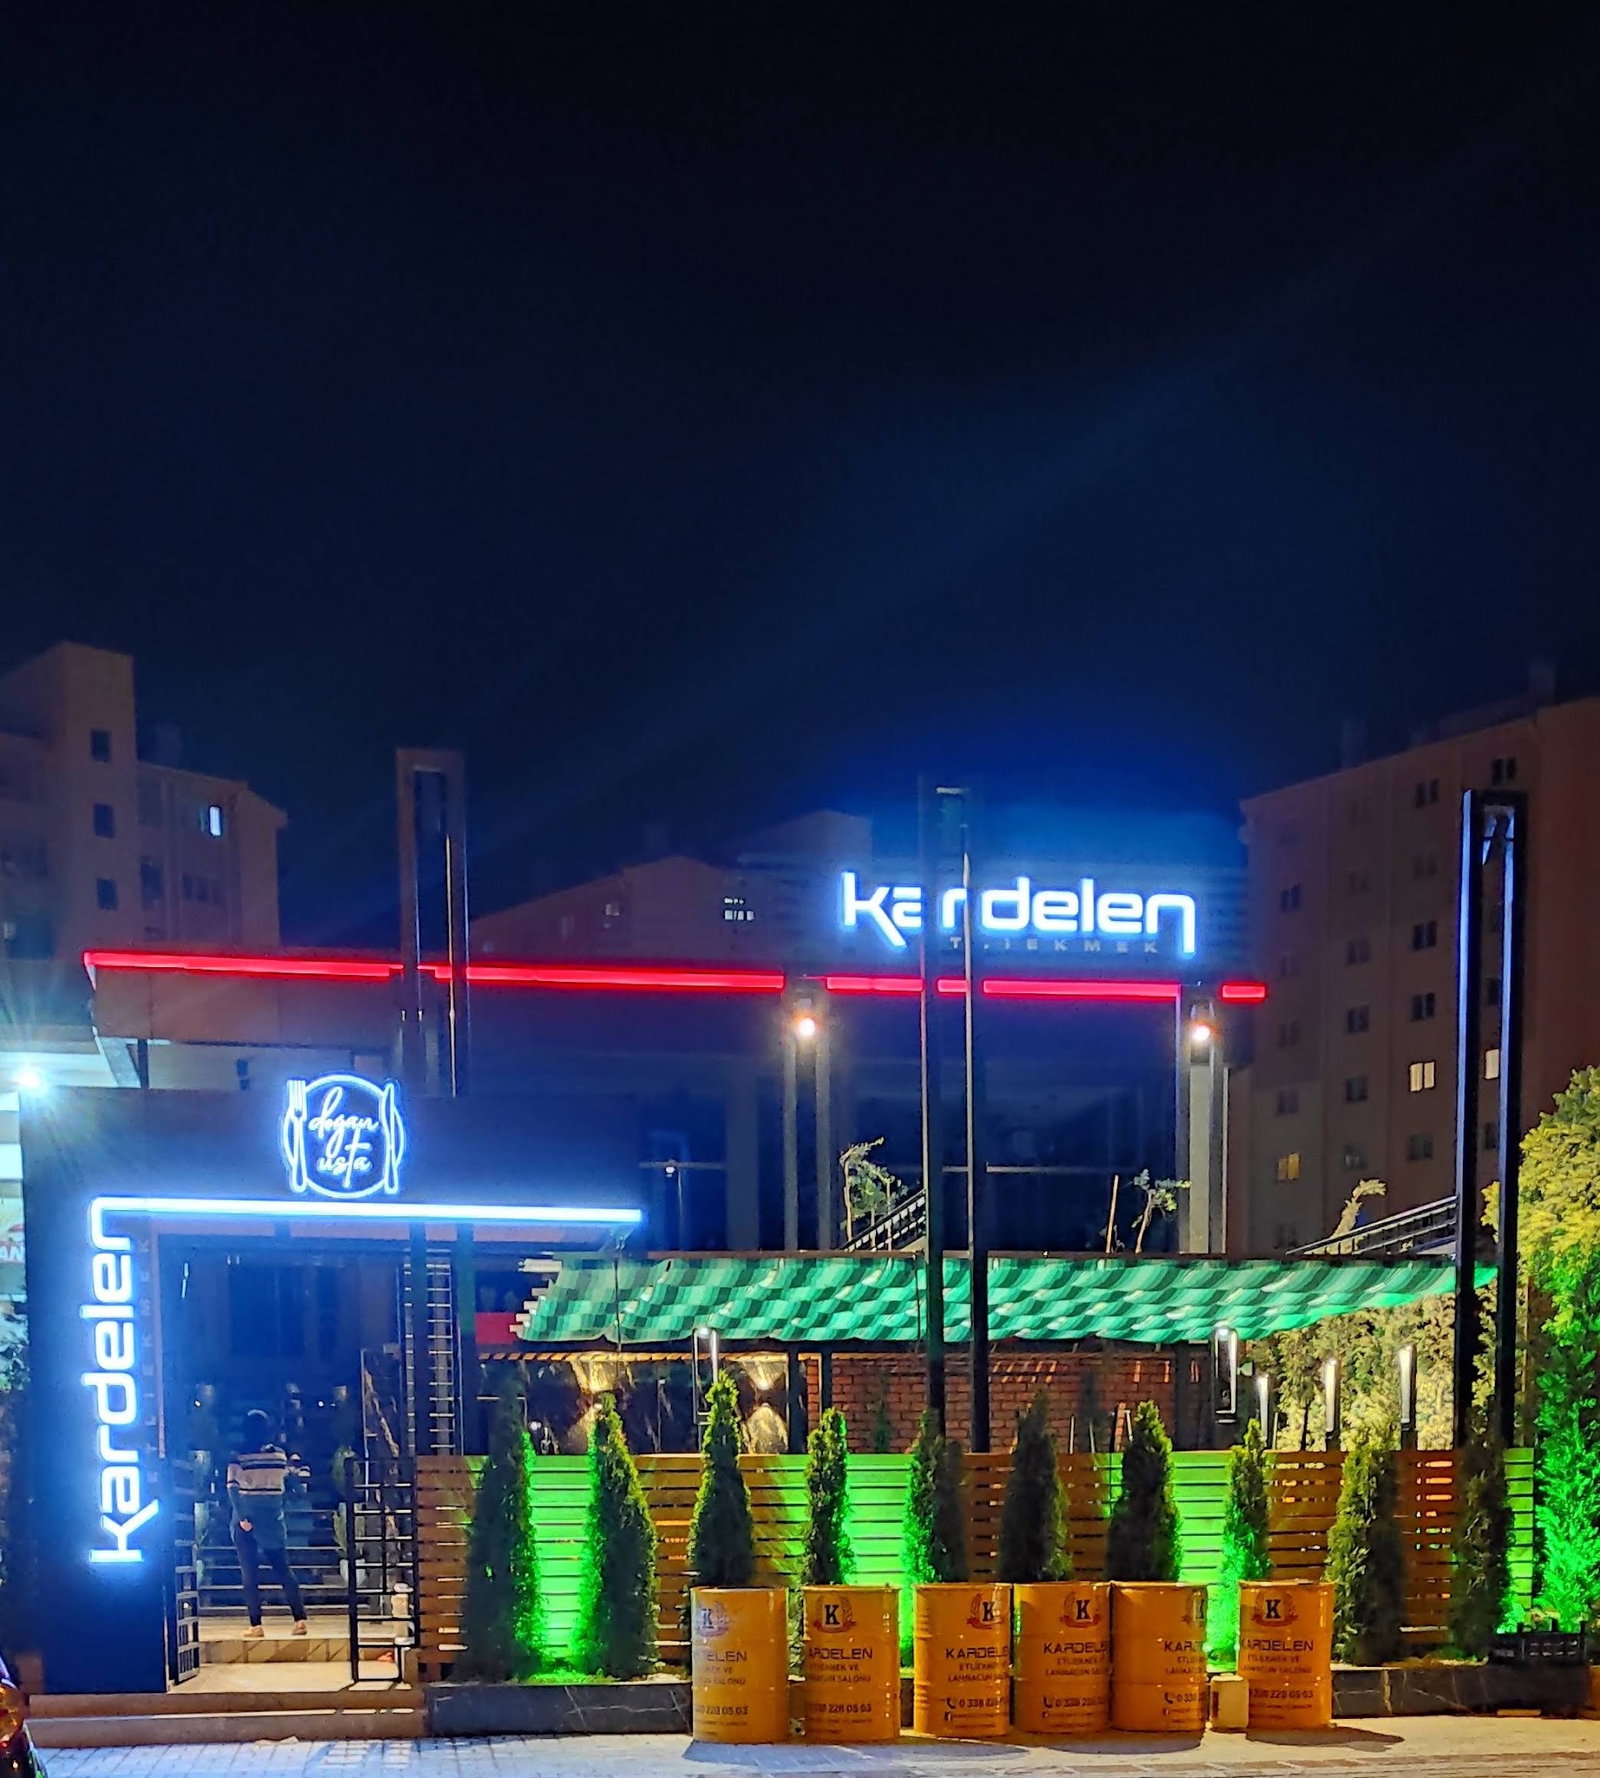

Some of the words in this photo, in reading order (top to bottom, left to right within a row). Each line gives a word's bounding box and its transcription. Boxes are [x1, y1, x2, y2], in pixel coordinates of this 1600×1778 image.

[842, 871, 1195, 953] kardelen
[80, 1196, 160, 1563] kardelen
[824, 1604, 840, 1625] K
[982, 1602, 996, 1621] K
[1076, 1600, 1091, 1620] K
[1265, 1599, 1281, 1619] K
